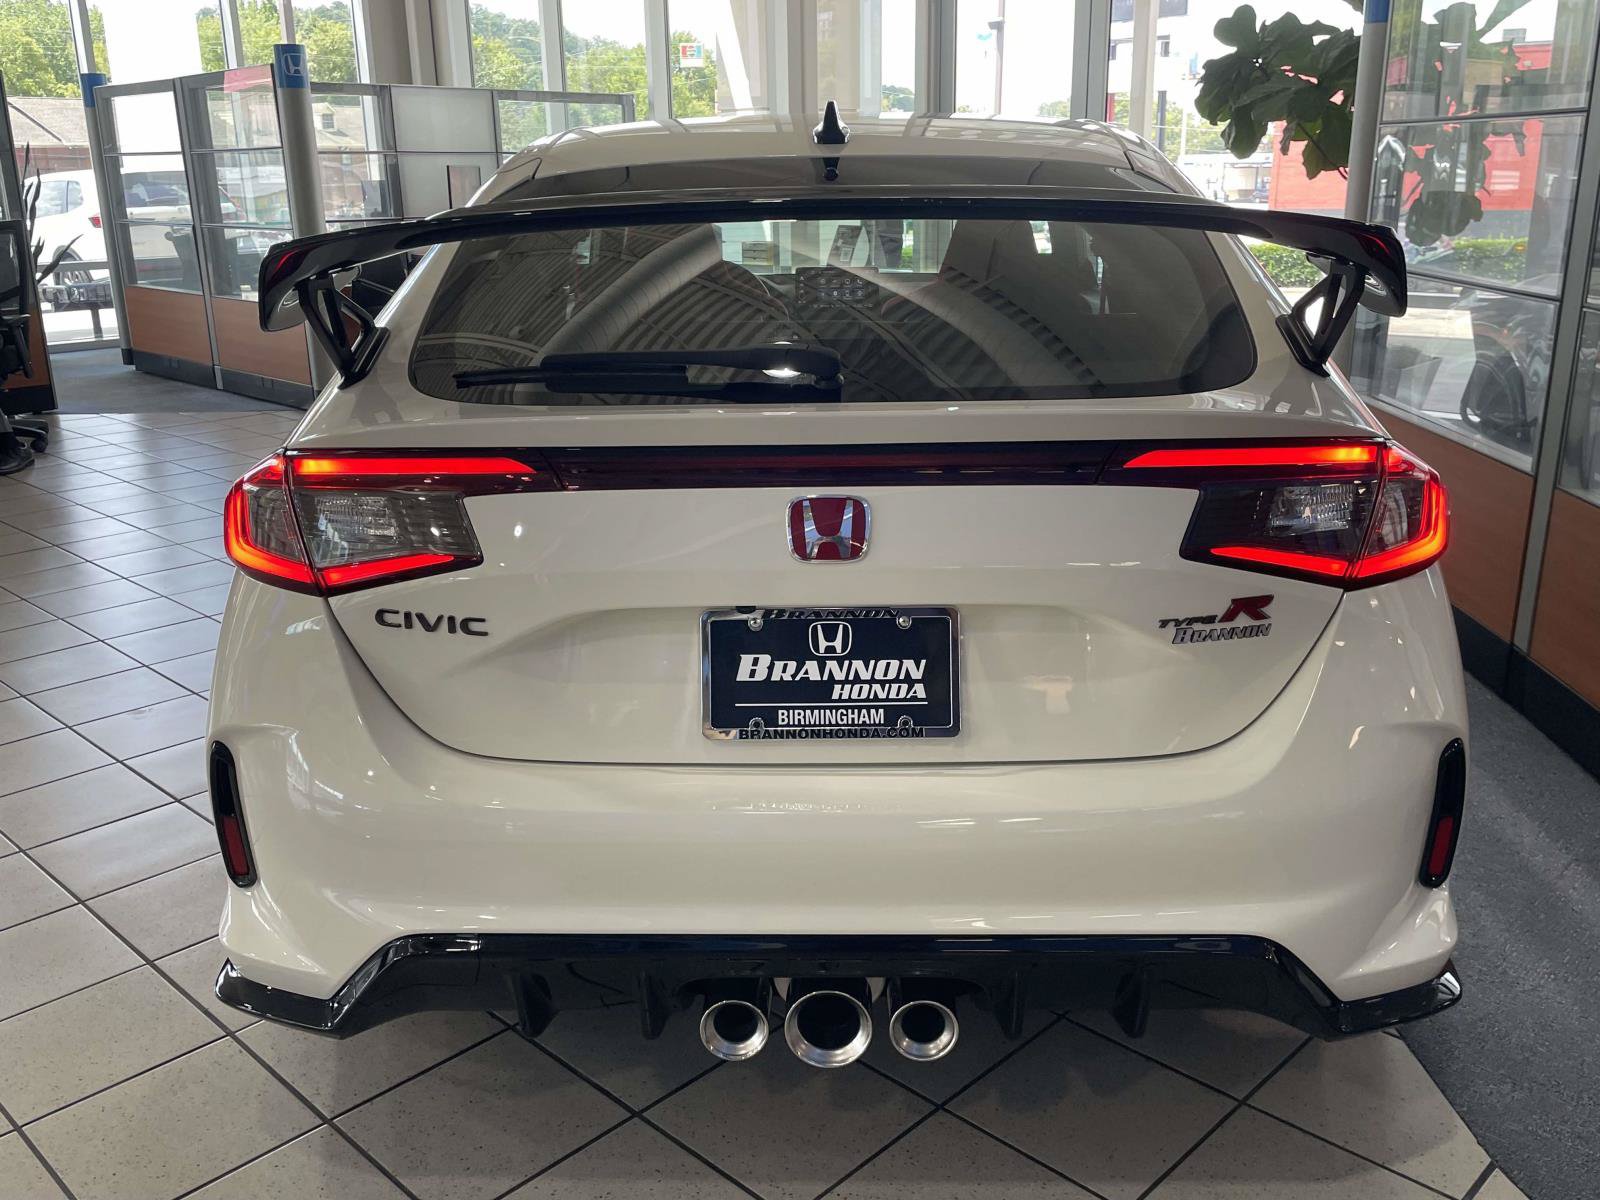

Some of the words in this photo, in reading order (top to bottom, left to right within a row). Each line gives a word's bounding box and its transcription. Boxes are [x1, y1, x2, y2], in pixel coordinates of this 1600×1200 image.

[763, 608, 900, 619] BRANNON
[1159, 614, 1218, 629] TYPE
[1218, 594, 1275, 623] R
[375, 608, 489, 636] CIVIC
[1172, 623, 1272, 645] BRANNON
[736, 653, 927, 682] BRANNON
[831, 683, 927, 700] HONDA
[778, 708, 885, 726] BIRMINGHAM
[739, 727, 925, 740] BRANNONHONDA.COM
